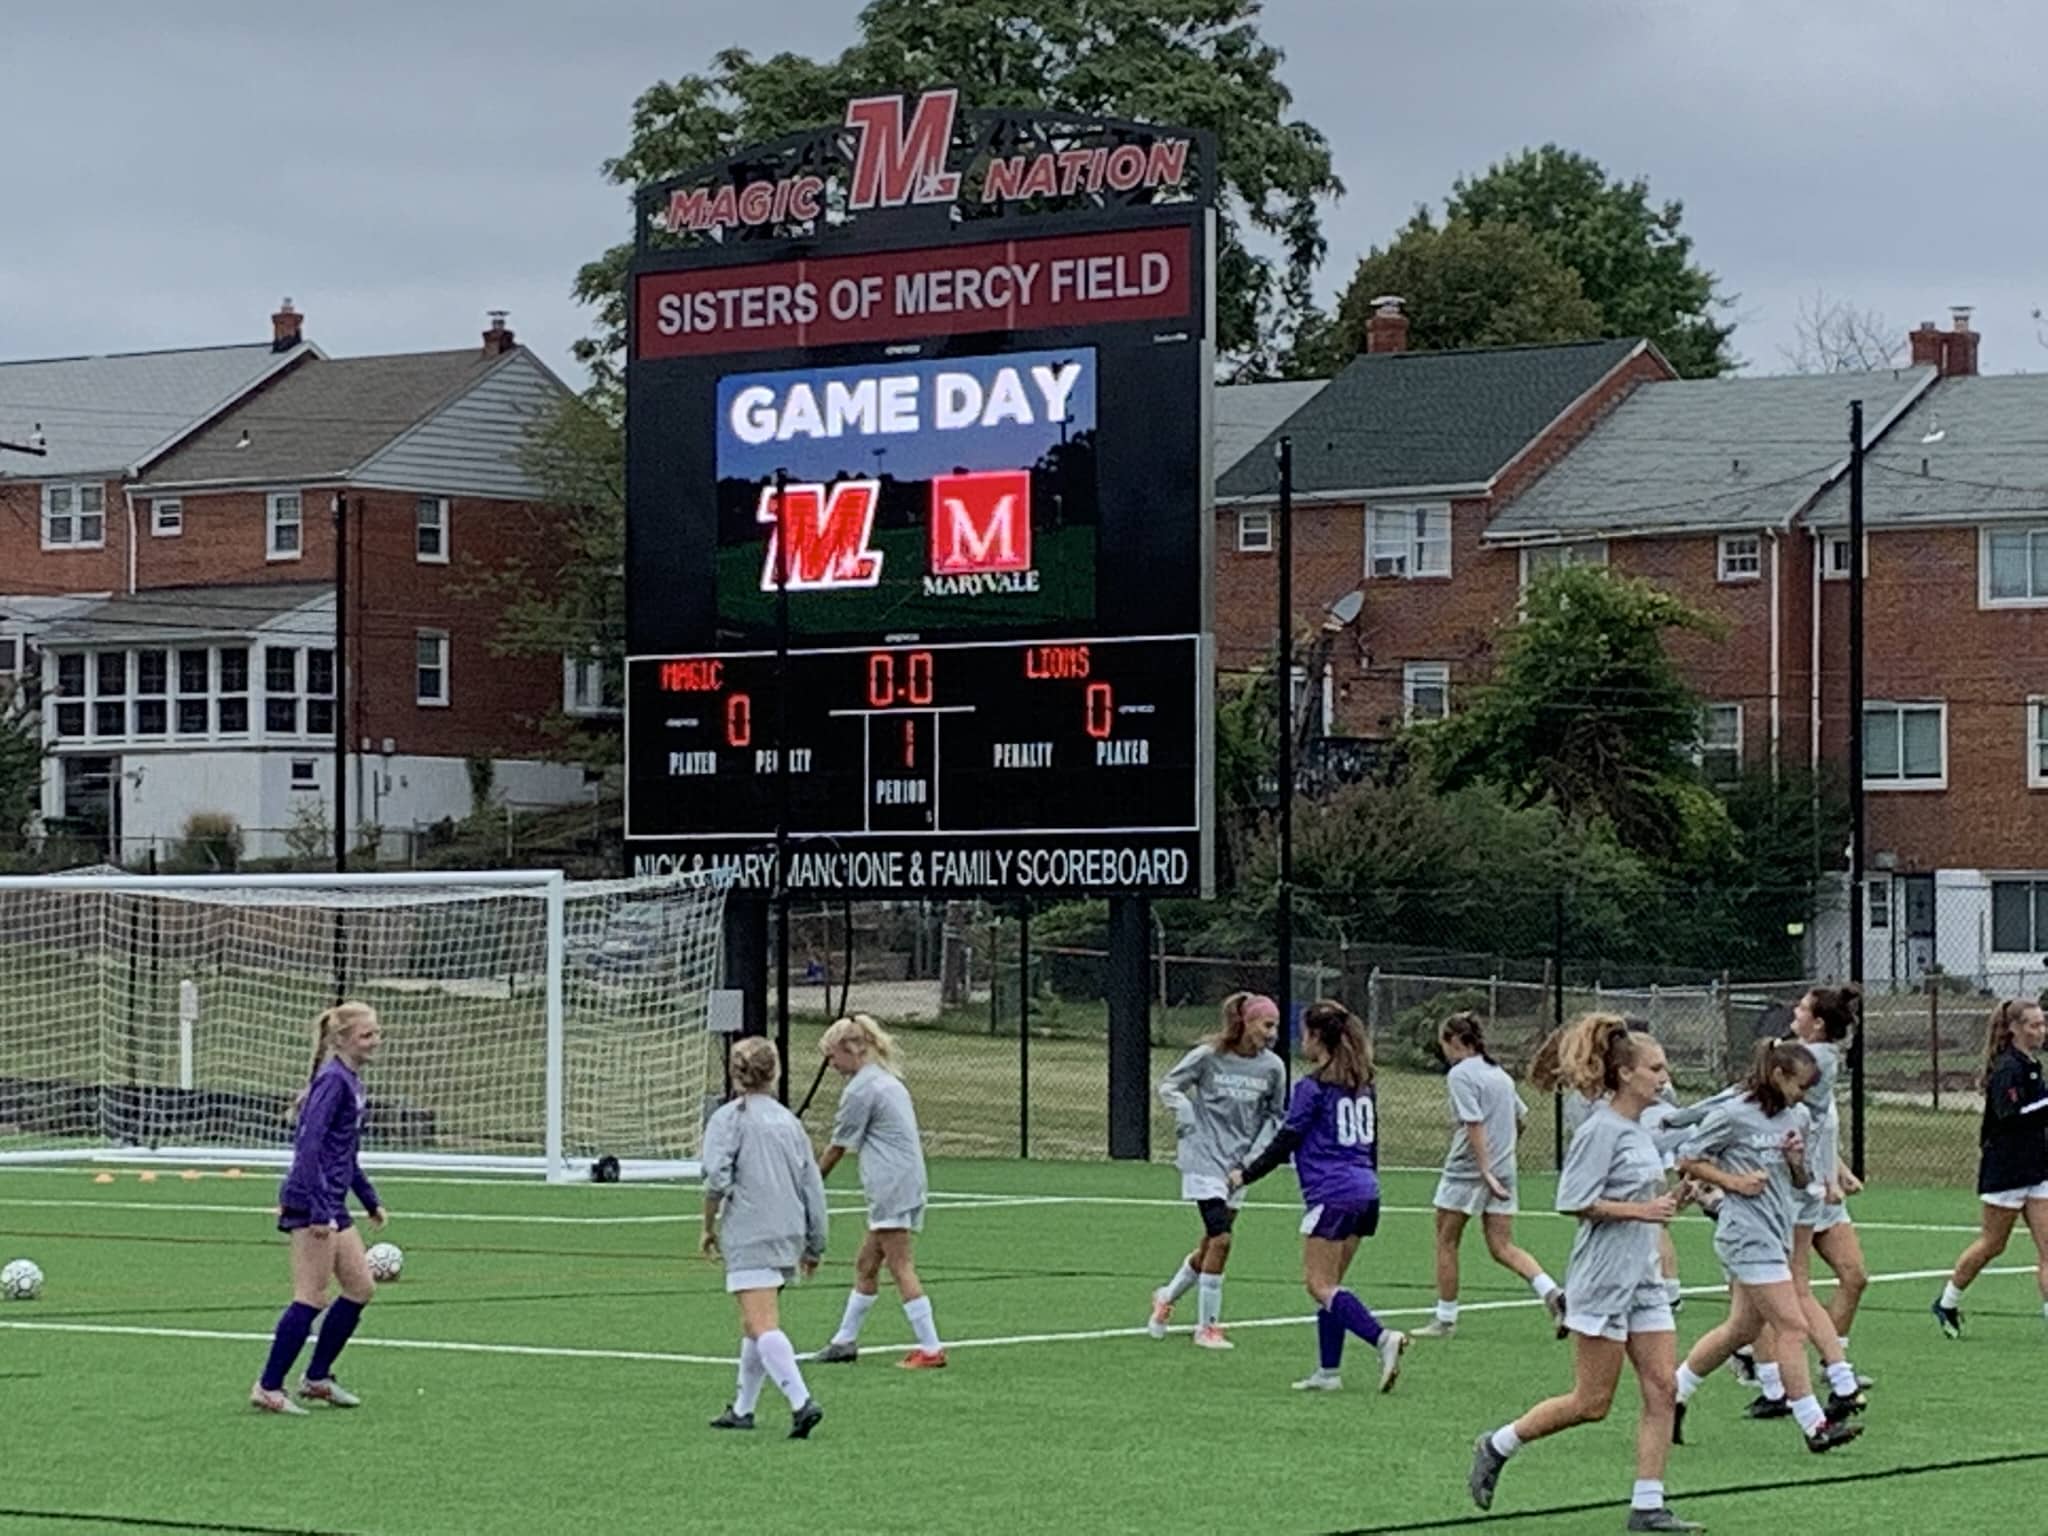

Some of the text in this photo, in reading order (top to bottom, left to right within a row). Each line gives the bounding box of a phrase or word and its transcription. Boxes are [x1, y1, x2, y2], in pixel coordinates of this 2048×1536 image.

[666, 139, 1190, 233] MAGIC NATION
[657, 252, 1171, 336] SISTERS OF MERCY FIELD
[730, 362, 1083, 444] GAME DAY
[943, 493, 1018, 568] M
[923, 569, 1040, 597] MARYVALE
[661, 660, 724, 691] MAGIC
[1026, 645, 1090, 679] LIONS
[727, 694, 750, 747] 0
[1087, 682, 1112, 738] 0
[669, 750, 717, 775] PLAYER
[755, 748, 812, 774] PELTY
[993, 742, 1053, 768] PENALTY
[1096, 739, 1149, 766] PLAYER
[876, 779, 927, 804] PERIOD
[634, 853, 687, 888] NICK
[711, 853, 777, 888] MARY
[908, 849, 926, 887] &
[931, 849, 1013, 887] FAMILY
[1016, 847, 1189, 887] SCOREBOARD
[1336, 1096, 1375, 1147] 00
